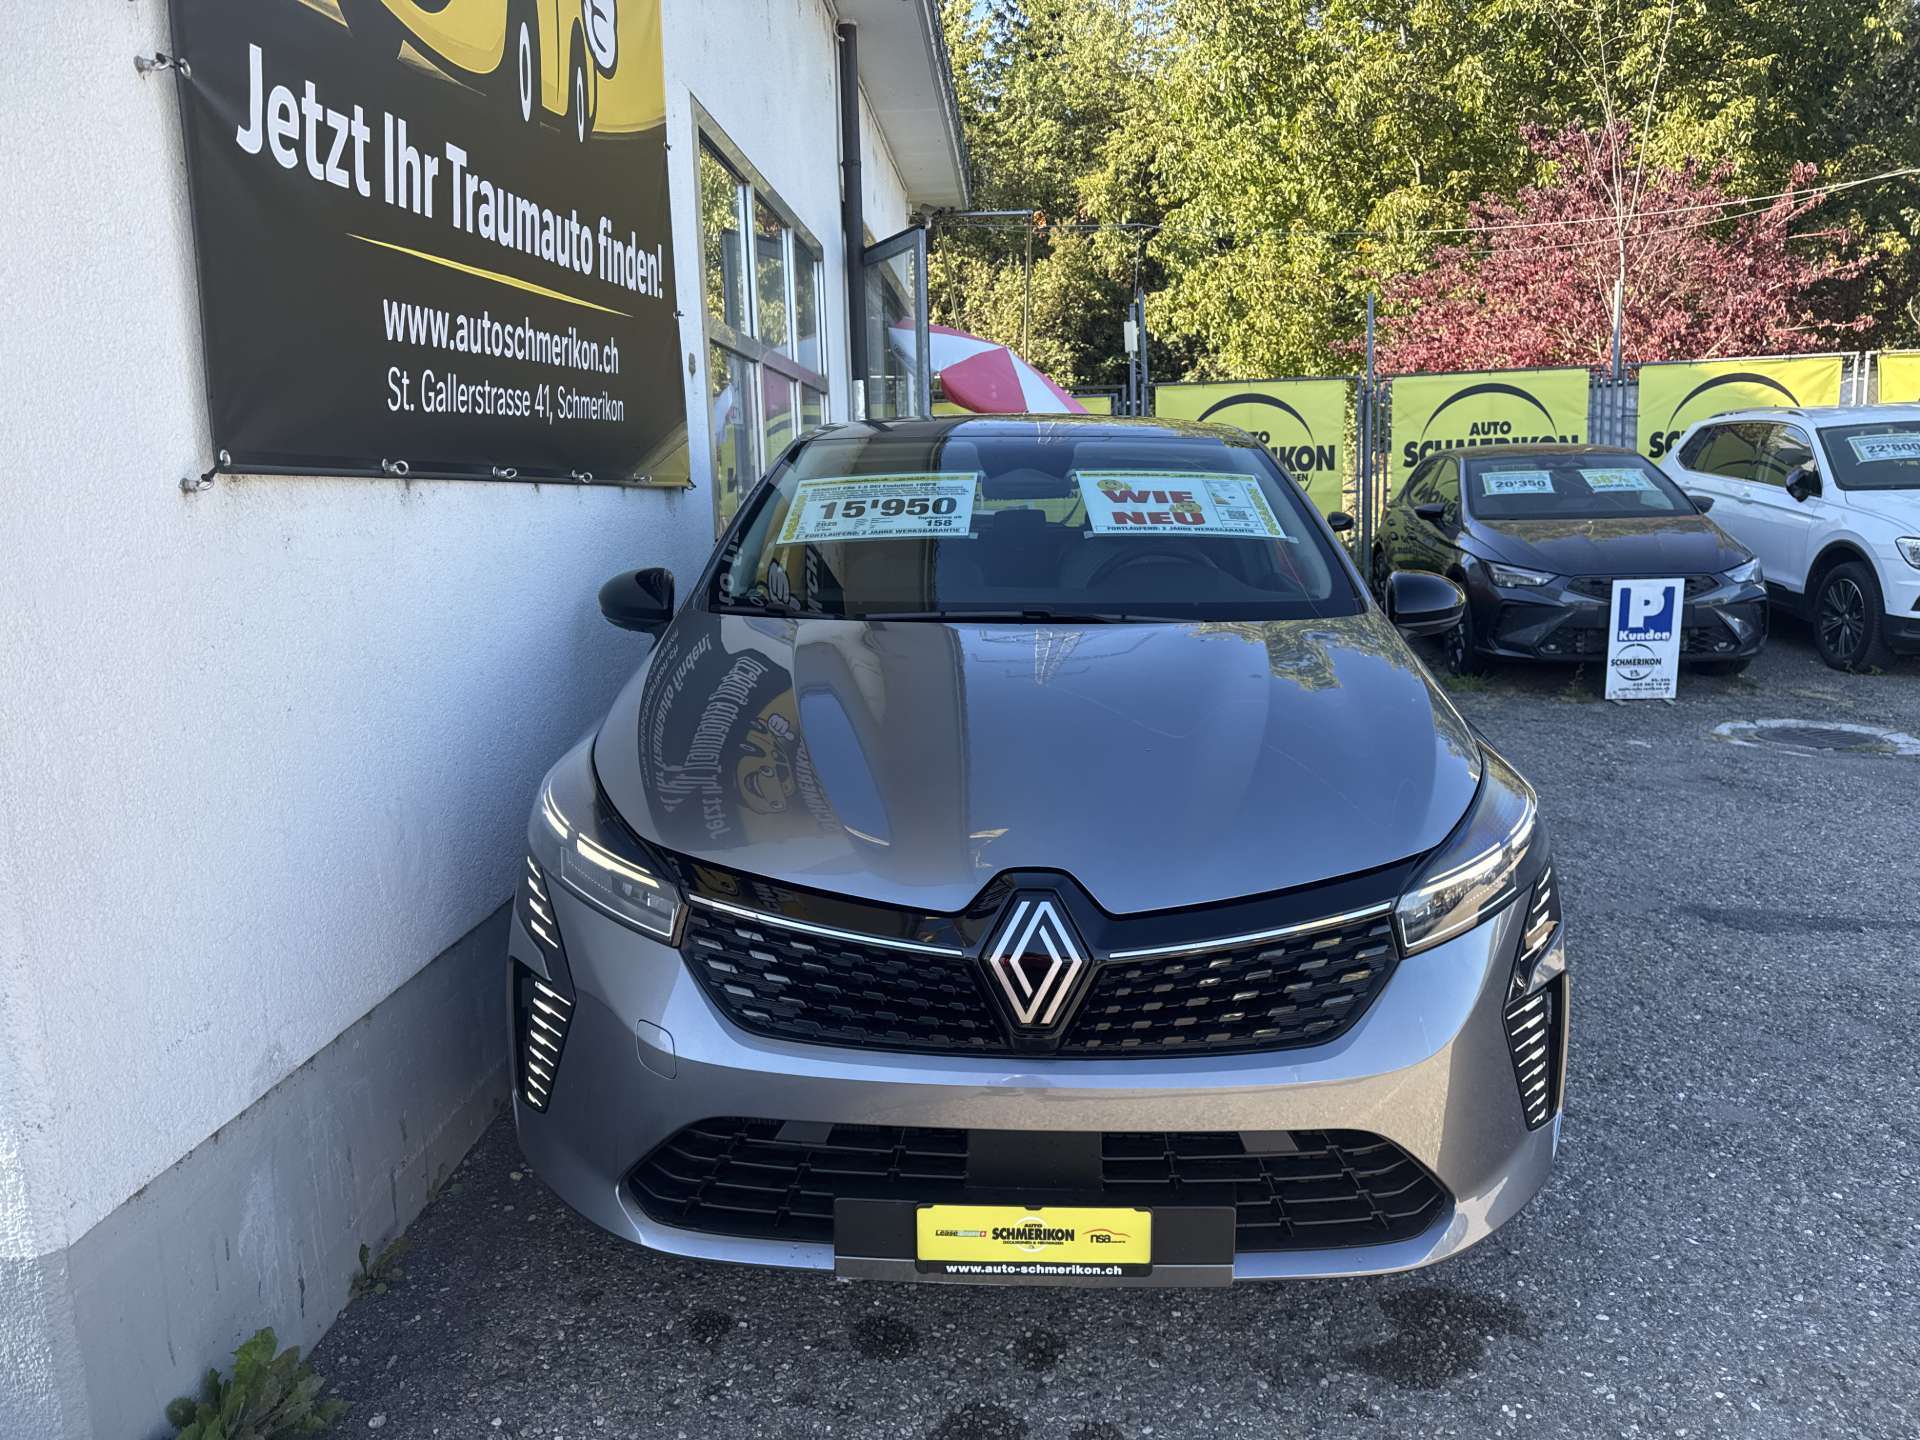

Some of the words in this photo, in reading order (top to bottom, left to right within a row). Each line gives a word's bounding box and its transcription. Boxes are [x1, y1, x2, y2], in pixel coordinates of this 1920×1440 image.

[236, 42, 371, 197] Jetzt
[384, 111, 438, 219] Ihr
[445, 141, 593, 275] Traumauto
[598, 216, 663, 299] finden!
[383, 298, 619, 374] www.autoschmerikon.ch
[387, 366, 415, 411] St.
[421, 369, 531, 416] Gallerstrasse
[534, 383, 553, 425] 41,
[557, 385, 624, 422] Schmerikon
[1469, 420, 1512, 436] AUTO
[1102, 490, 1193, 504] WIE
[820, 496, 957, 520] 15'950
[926, 519, 953, 527] 158
[1111, 511, 1206, 525] NEU
[1628, 585, 1666, 628] P
[1618, 629, 1670, 641] Kunden
[1611, 657, 1661, 667] SCHMERIKON
[991, 1227, 1075, 1242] SCHMERIKON
[1090, 1234, 1111, 1244] nsa
[945, 1264, 1123, 1275] www.auto-schmerikon.ch
